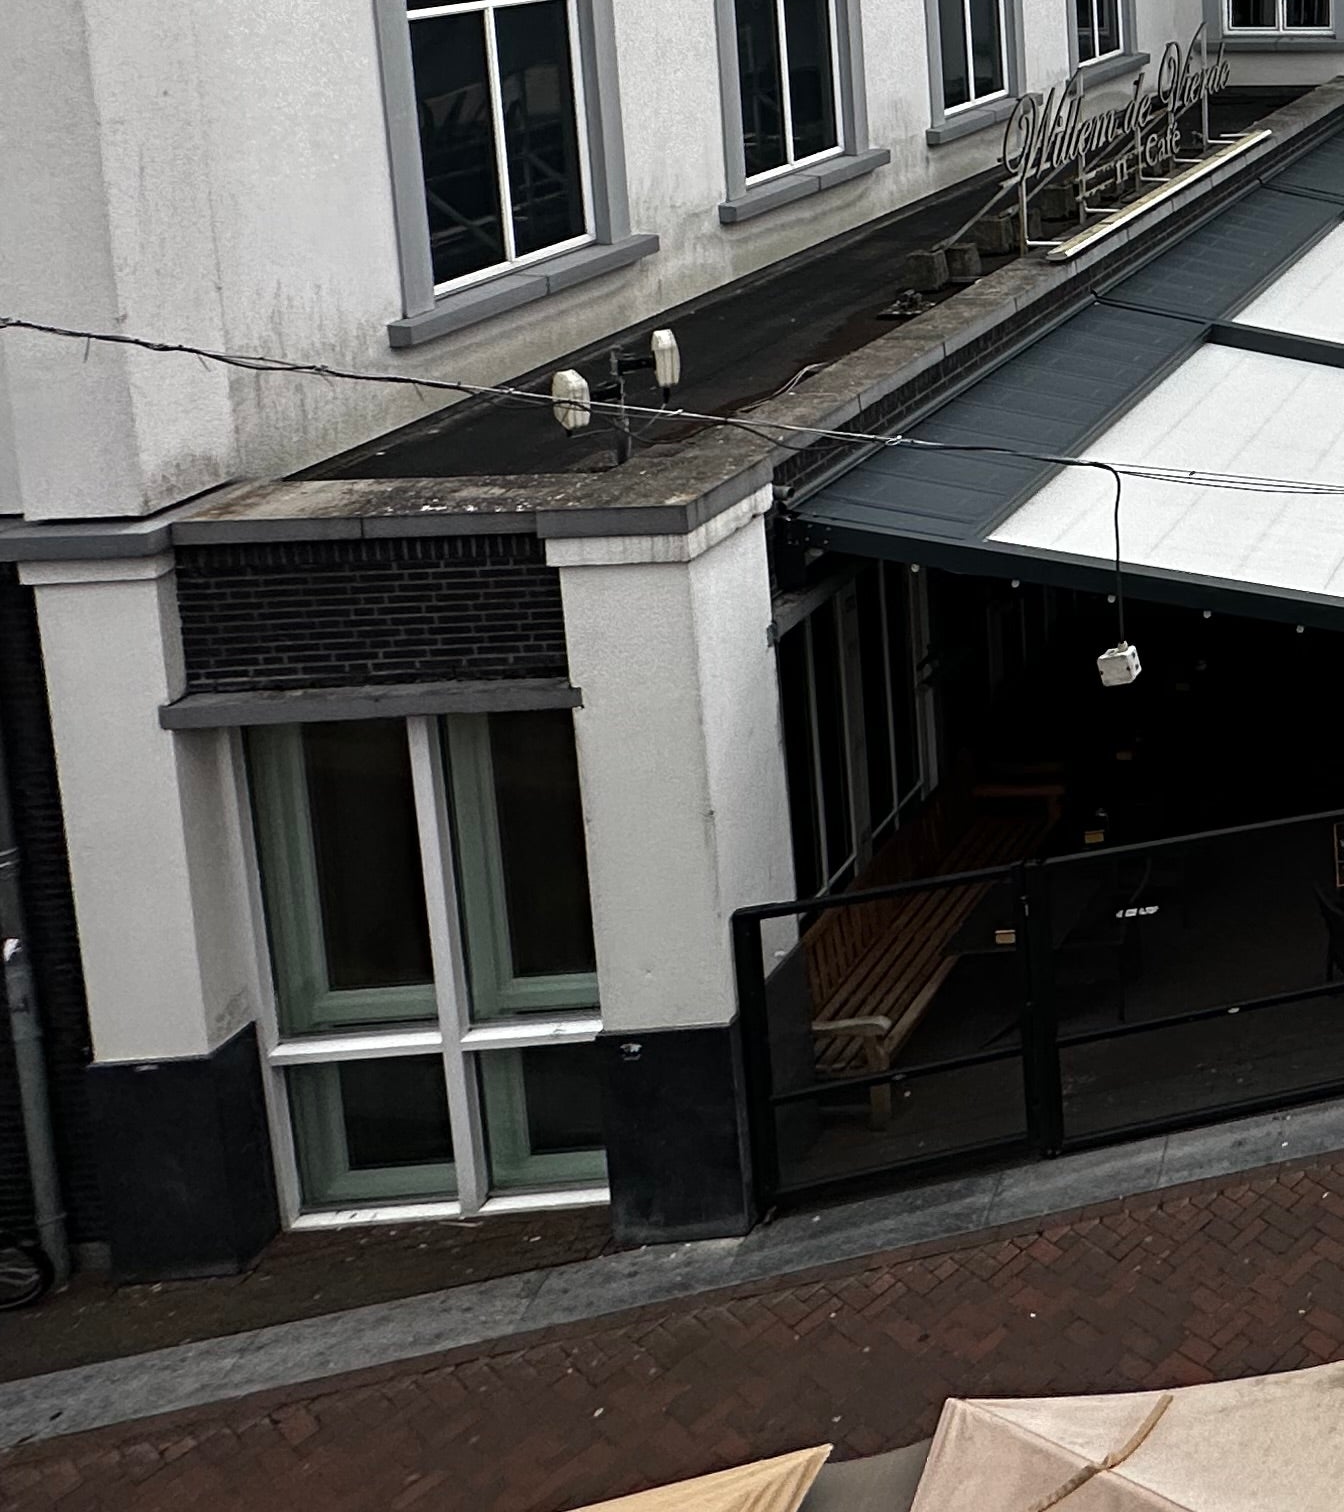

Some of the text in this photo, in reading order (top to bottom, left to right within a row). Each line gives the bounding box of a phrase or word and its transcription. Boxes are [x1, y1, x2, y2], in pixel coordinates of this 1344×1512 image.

[1003, 21, 1230, 183] Willem de Vierde
[1145, 121, 1182, 166] Café
